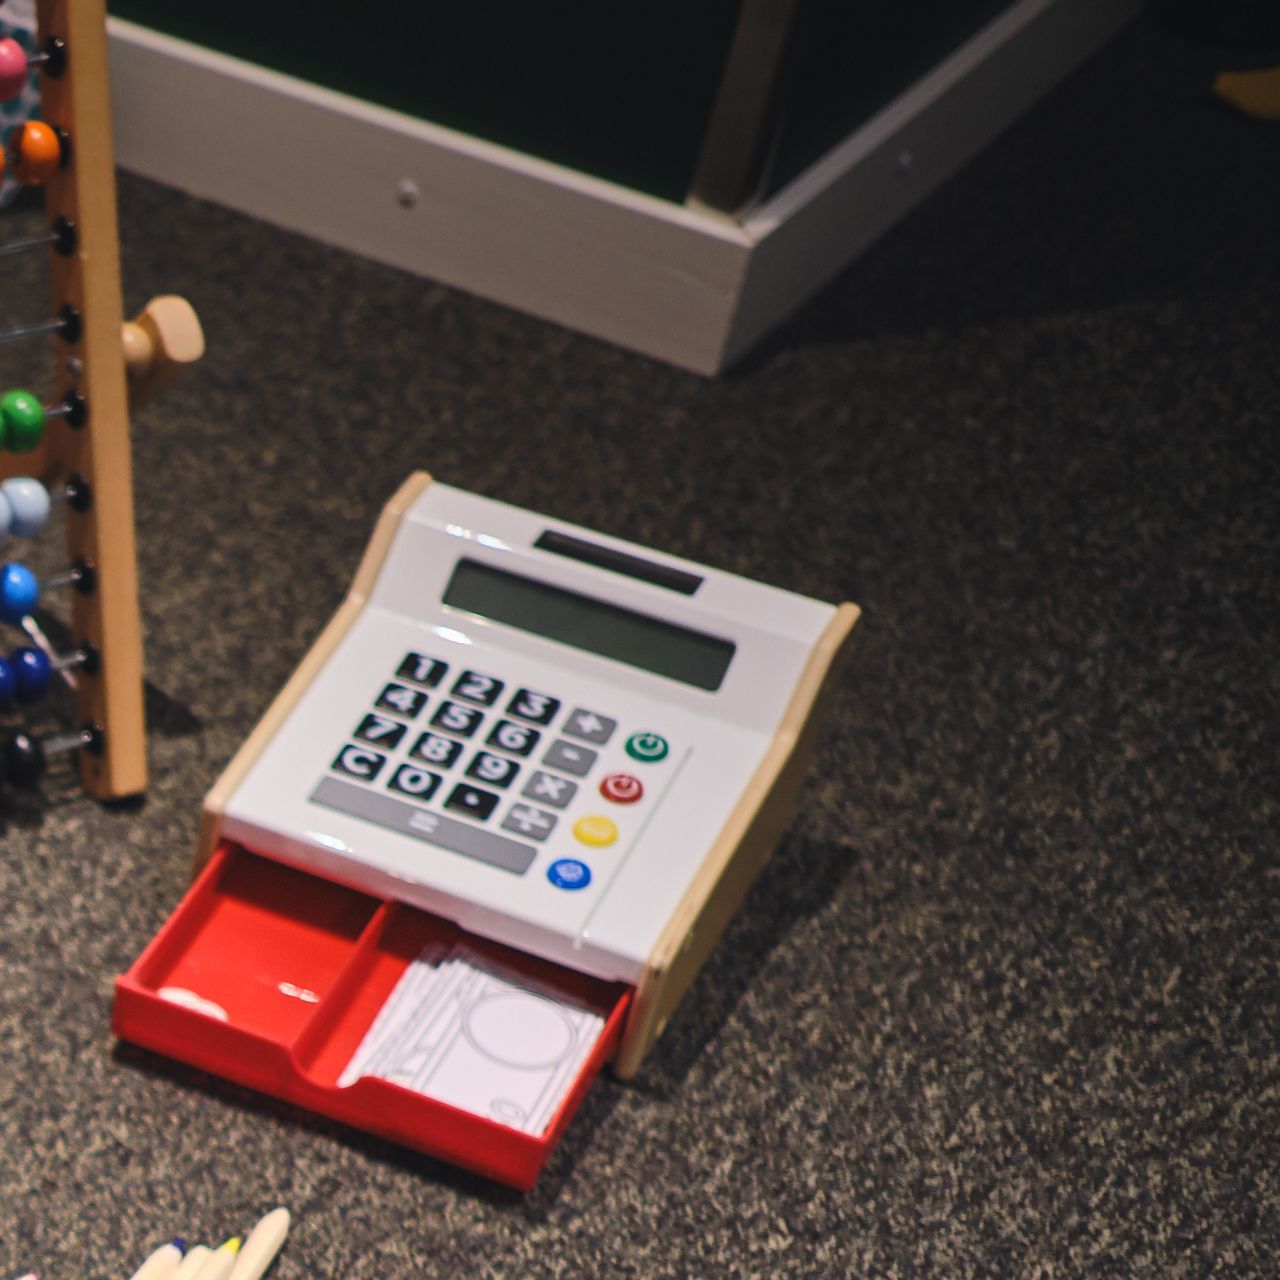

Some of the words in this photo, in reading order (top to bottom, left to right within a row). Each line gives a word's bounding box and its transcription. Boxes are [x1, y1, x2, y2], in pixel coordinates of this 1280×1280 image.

[415, 657, 436, 681] 1
[462, 674, 495, 701] 2
[518, 692, 551, 717] 3
[384, 688, 418, 712] 4
[440, 705, 473, 729] 5
[498, 723, 530, 749] 6
[342, 748, 380, 775] C
[366, 717, 399, 739] 7
[420, 734, 452, 762] 8
[478, 754, 509, 781] 9
